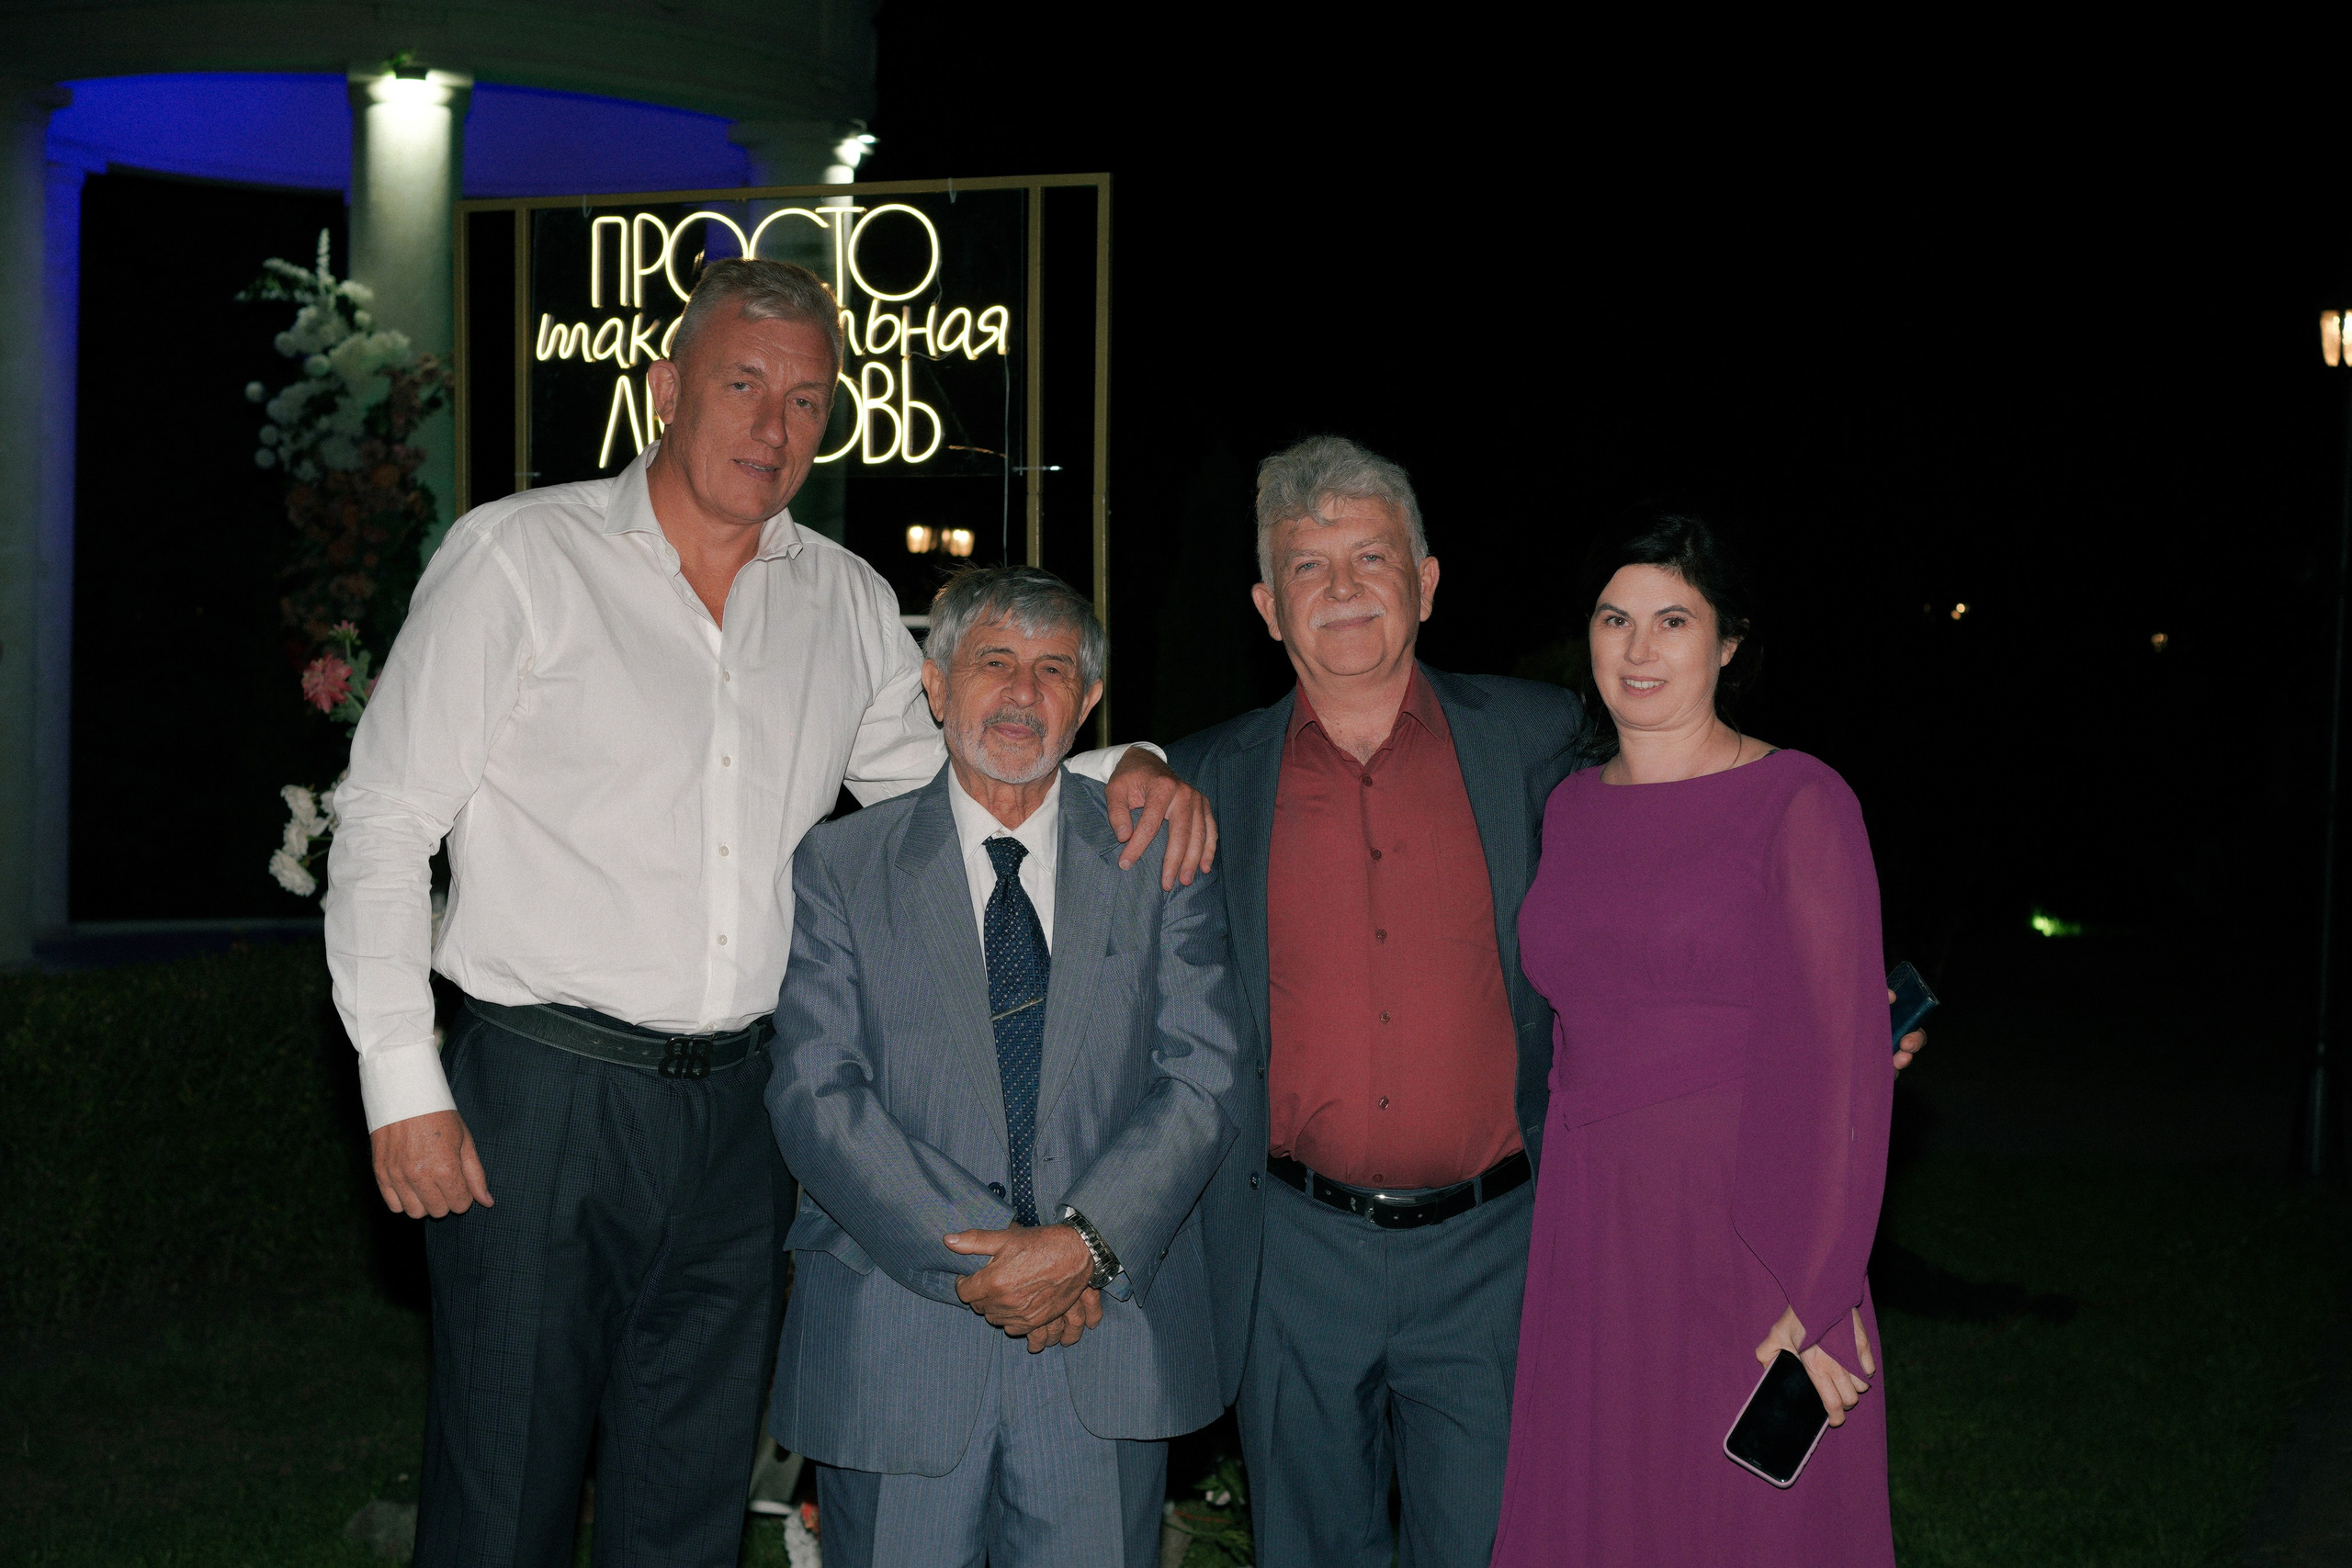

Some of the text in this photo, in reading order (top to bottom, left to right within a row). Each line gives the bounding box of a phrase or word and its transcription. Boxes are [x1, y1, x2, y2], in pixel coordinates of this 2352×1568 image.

[591, 204, 939, 308] ПРОСТО
[537, 299, 1010, 369] так льная
